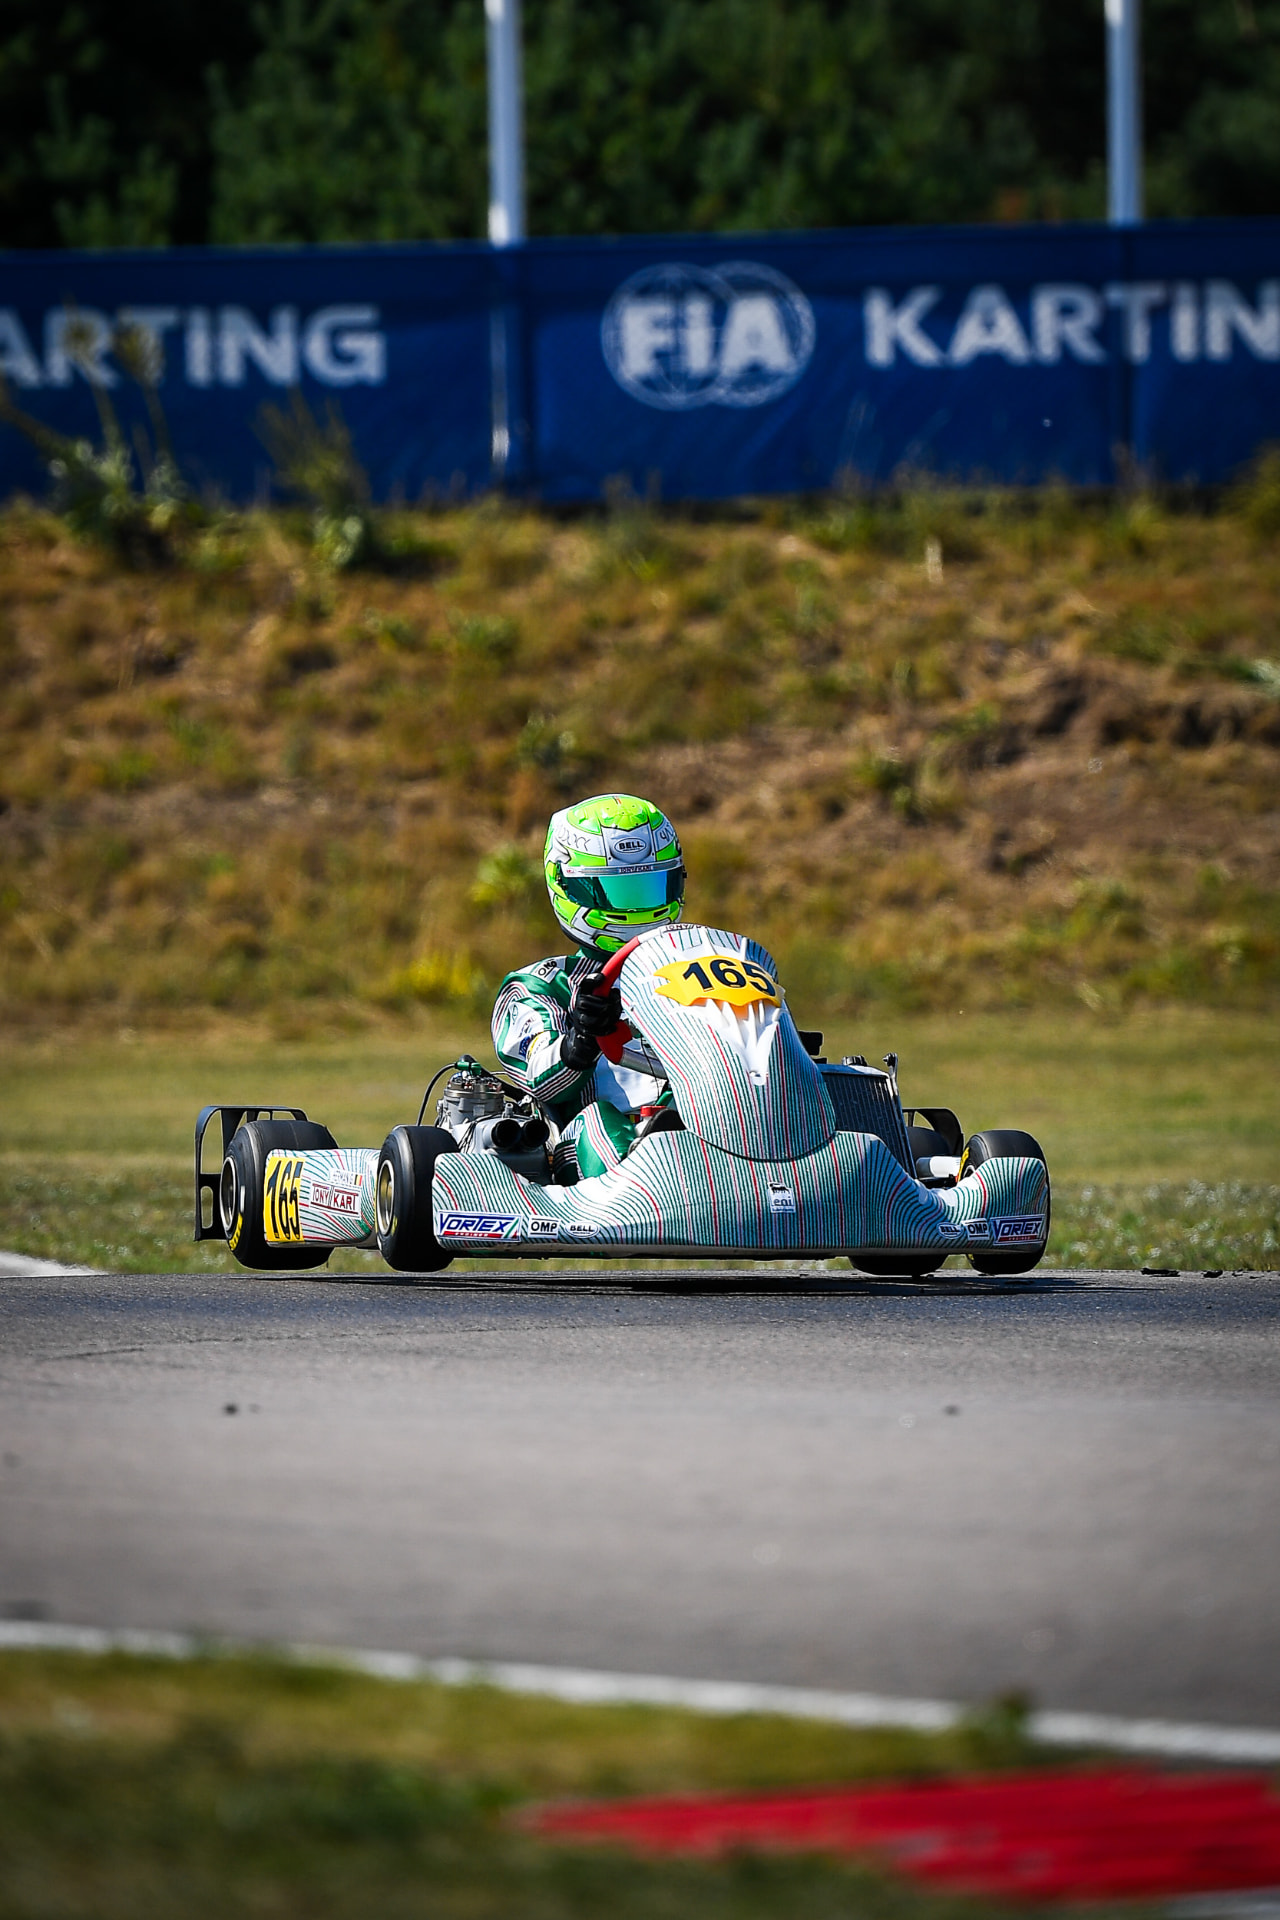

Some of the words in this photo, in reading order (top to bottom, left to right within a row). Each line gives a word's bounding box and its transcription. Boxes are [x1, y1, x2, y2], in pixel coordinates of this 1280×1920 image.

[863, 279, 1280, 368] KARTIN
[618, 840, 643, 850] BELL
[683, 959, 776, 997] 165
[266, 1160, 303, 1240] 165
[313, 1183, 330, 1204] TONY
[333, 1188, 359, 1210] KART
[773, 1196, 792, 1206] eni
[440, 1213, 515, 1233] VORTEX
[530, 1221, 557, 1233] OMP
[569, 1225, 594, 1233] BELL
[940, 1225, 961, 1233] BELL
[967, 1223, 988, 1234] OMP
[993, 1218, 1043, 1240] VORTEX
